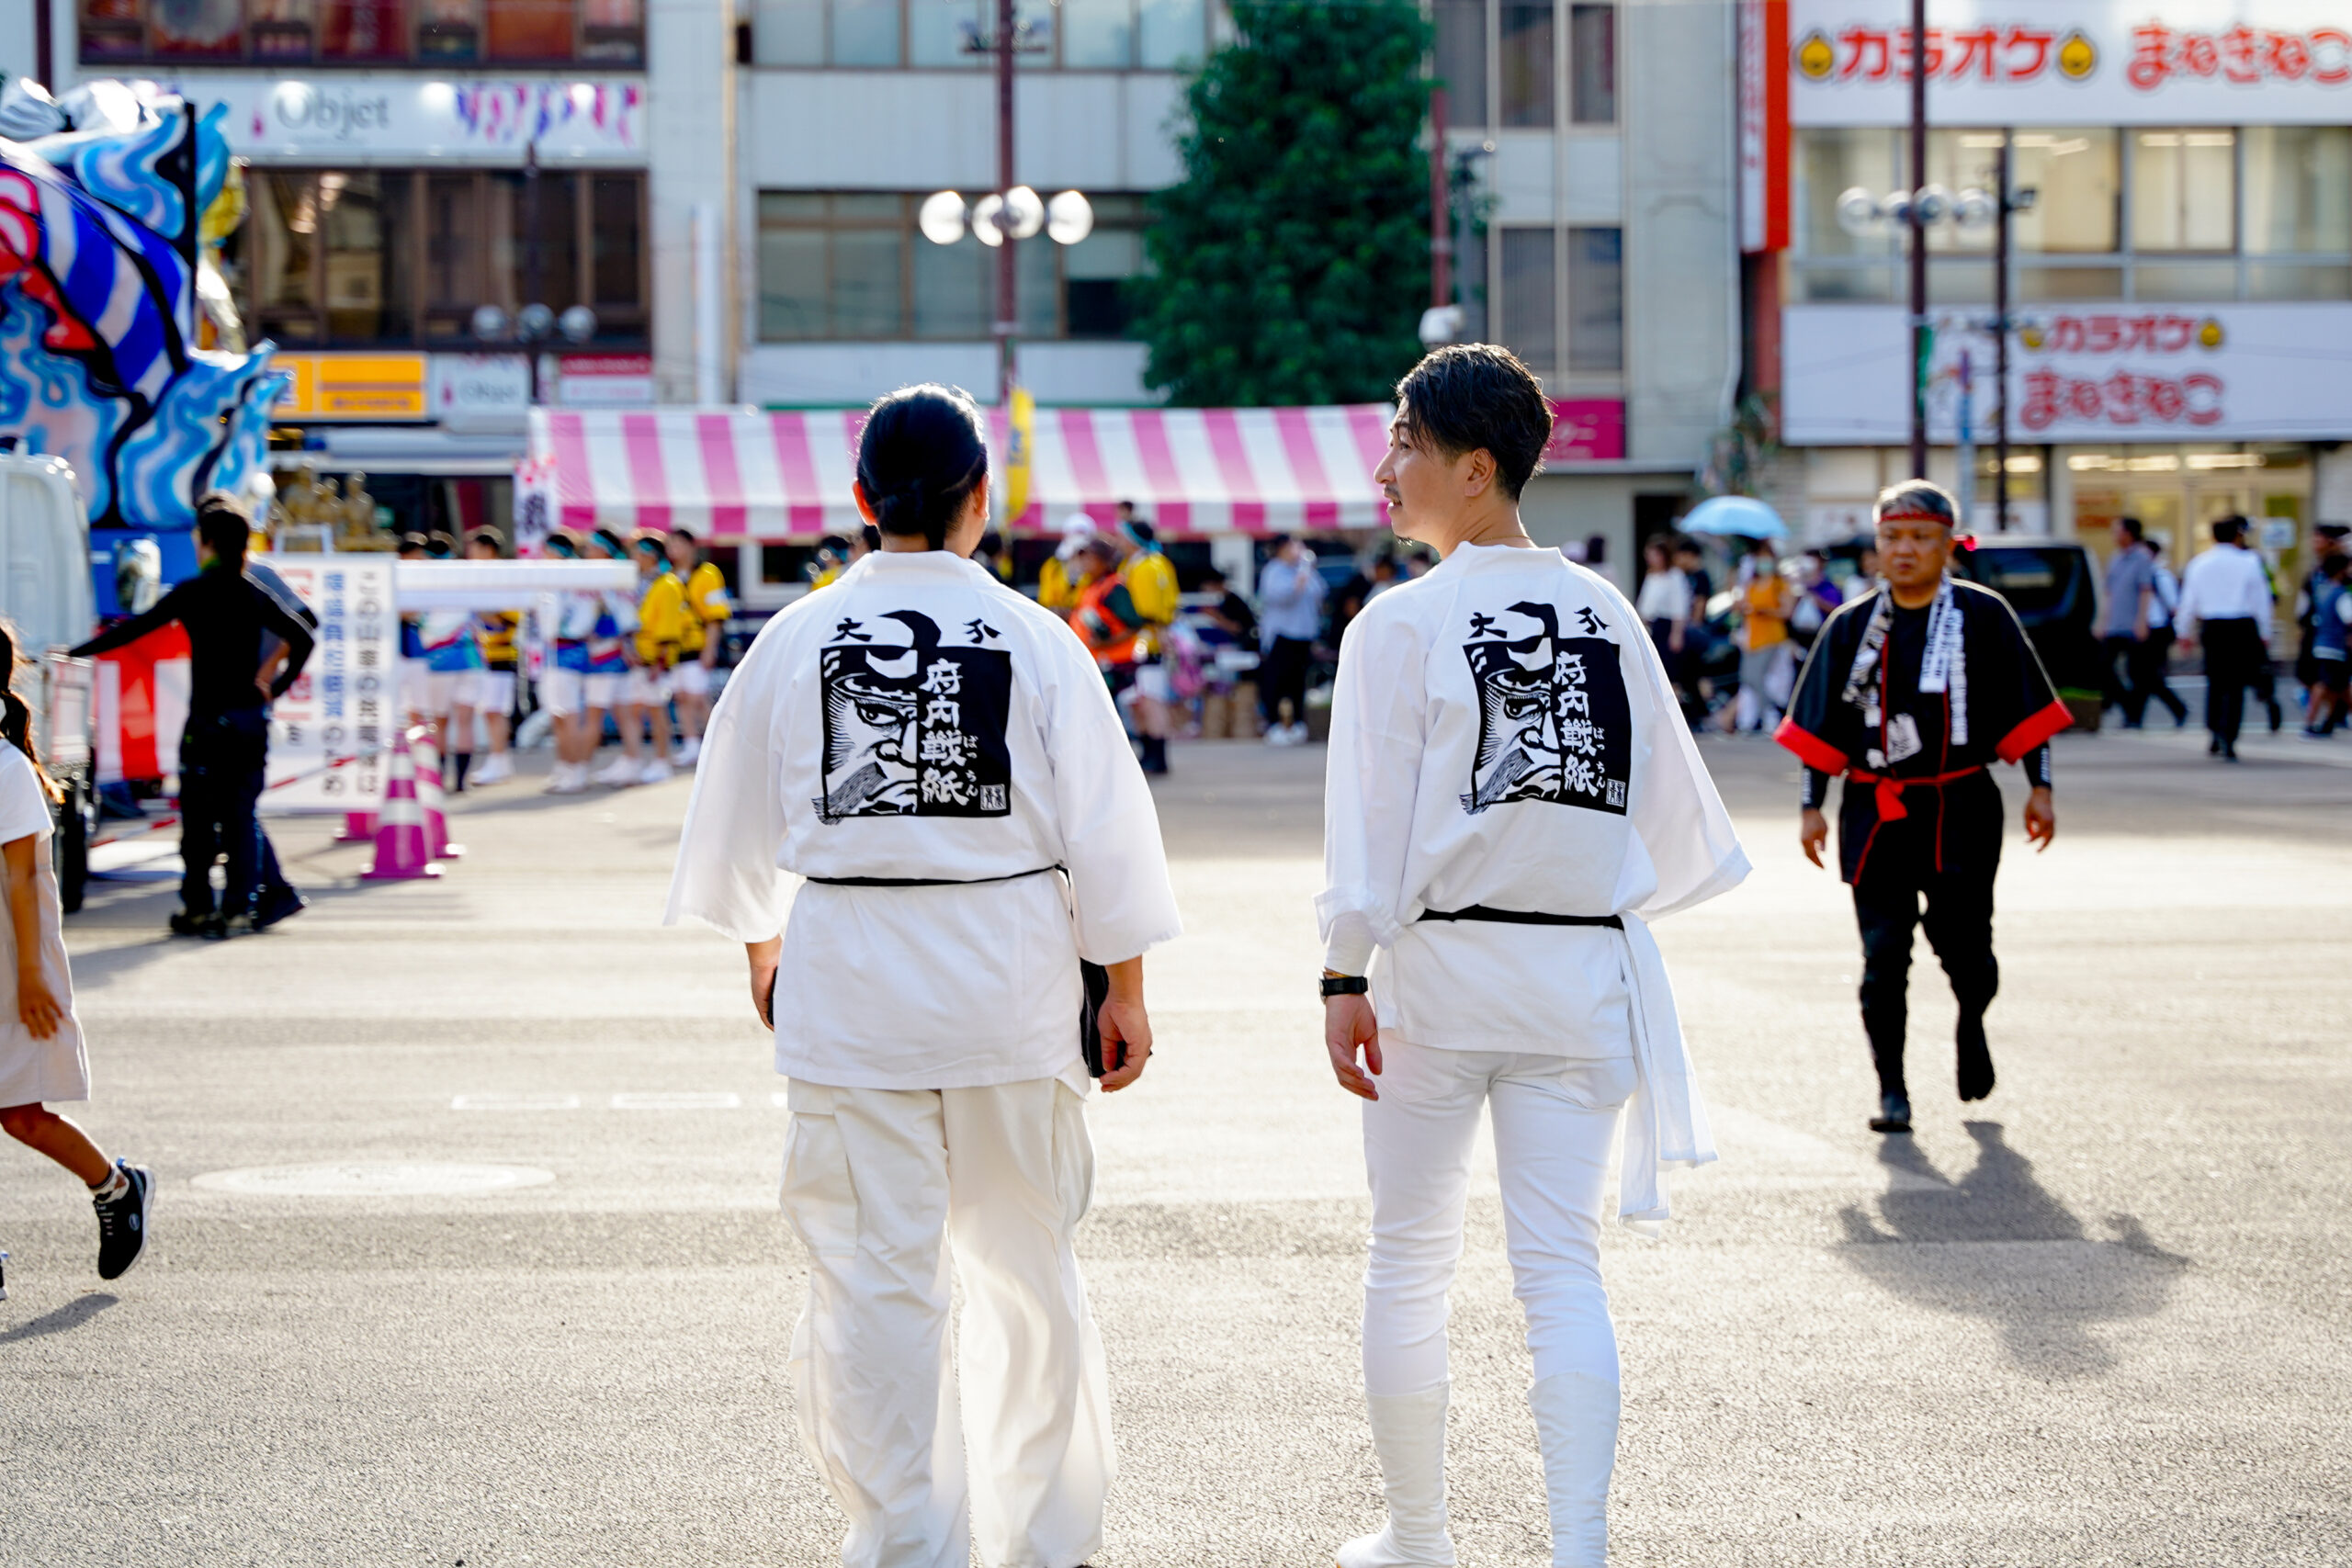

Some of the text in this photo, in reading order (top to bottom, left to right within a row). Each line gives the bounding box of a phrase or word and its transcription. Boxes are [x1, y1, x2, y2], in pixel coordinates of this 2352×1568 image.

[1840, 27, 2054, 81] カラオケ
[2127, 19, 2352, 90] まねきねこ
[277, 86, 390, 140] Objet
[2050, 314, 2195, 353] カラオケ
[2019, 366, 2223, 431] まねきねこ
